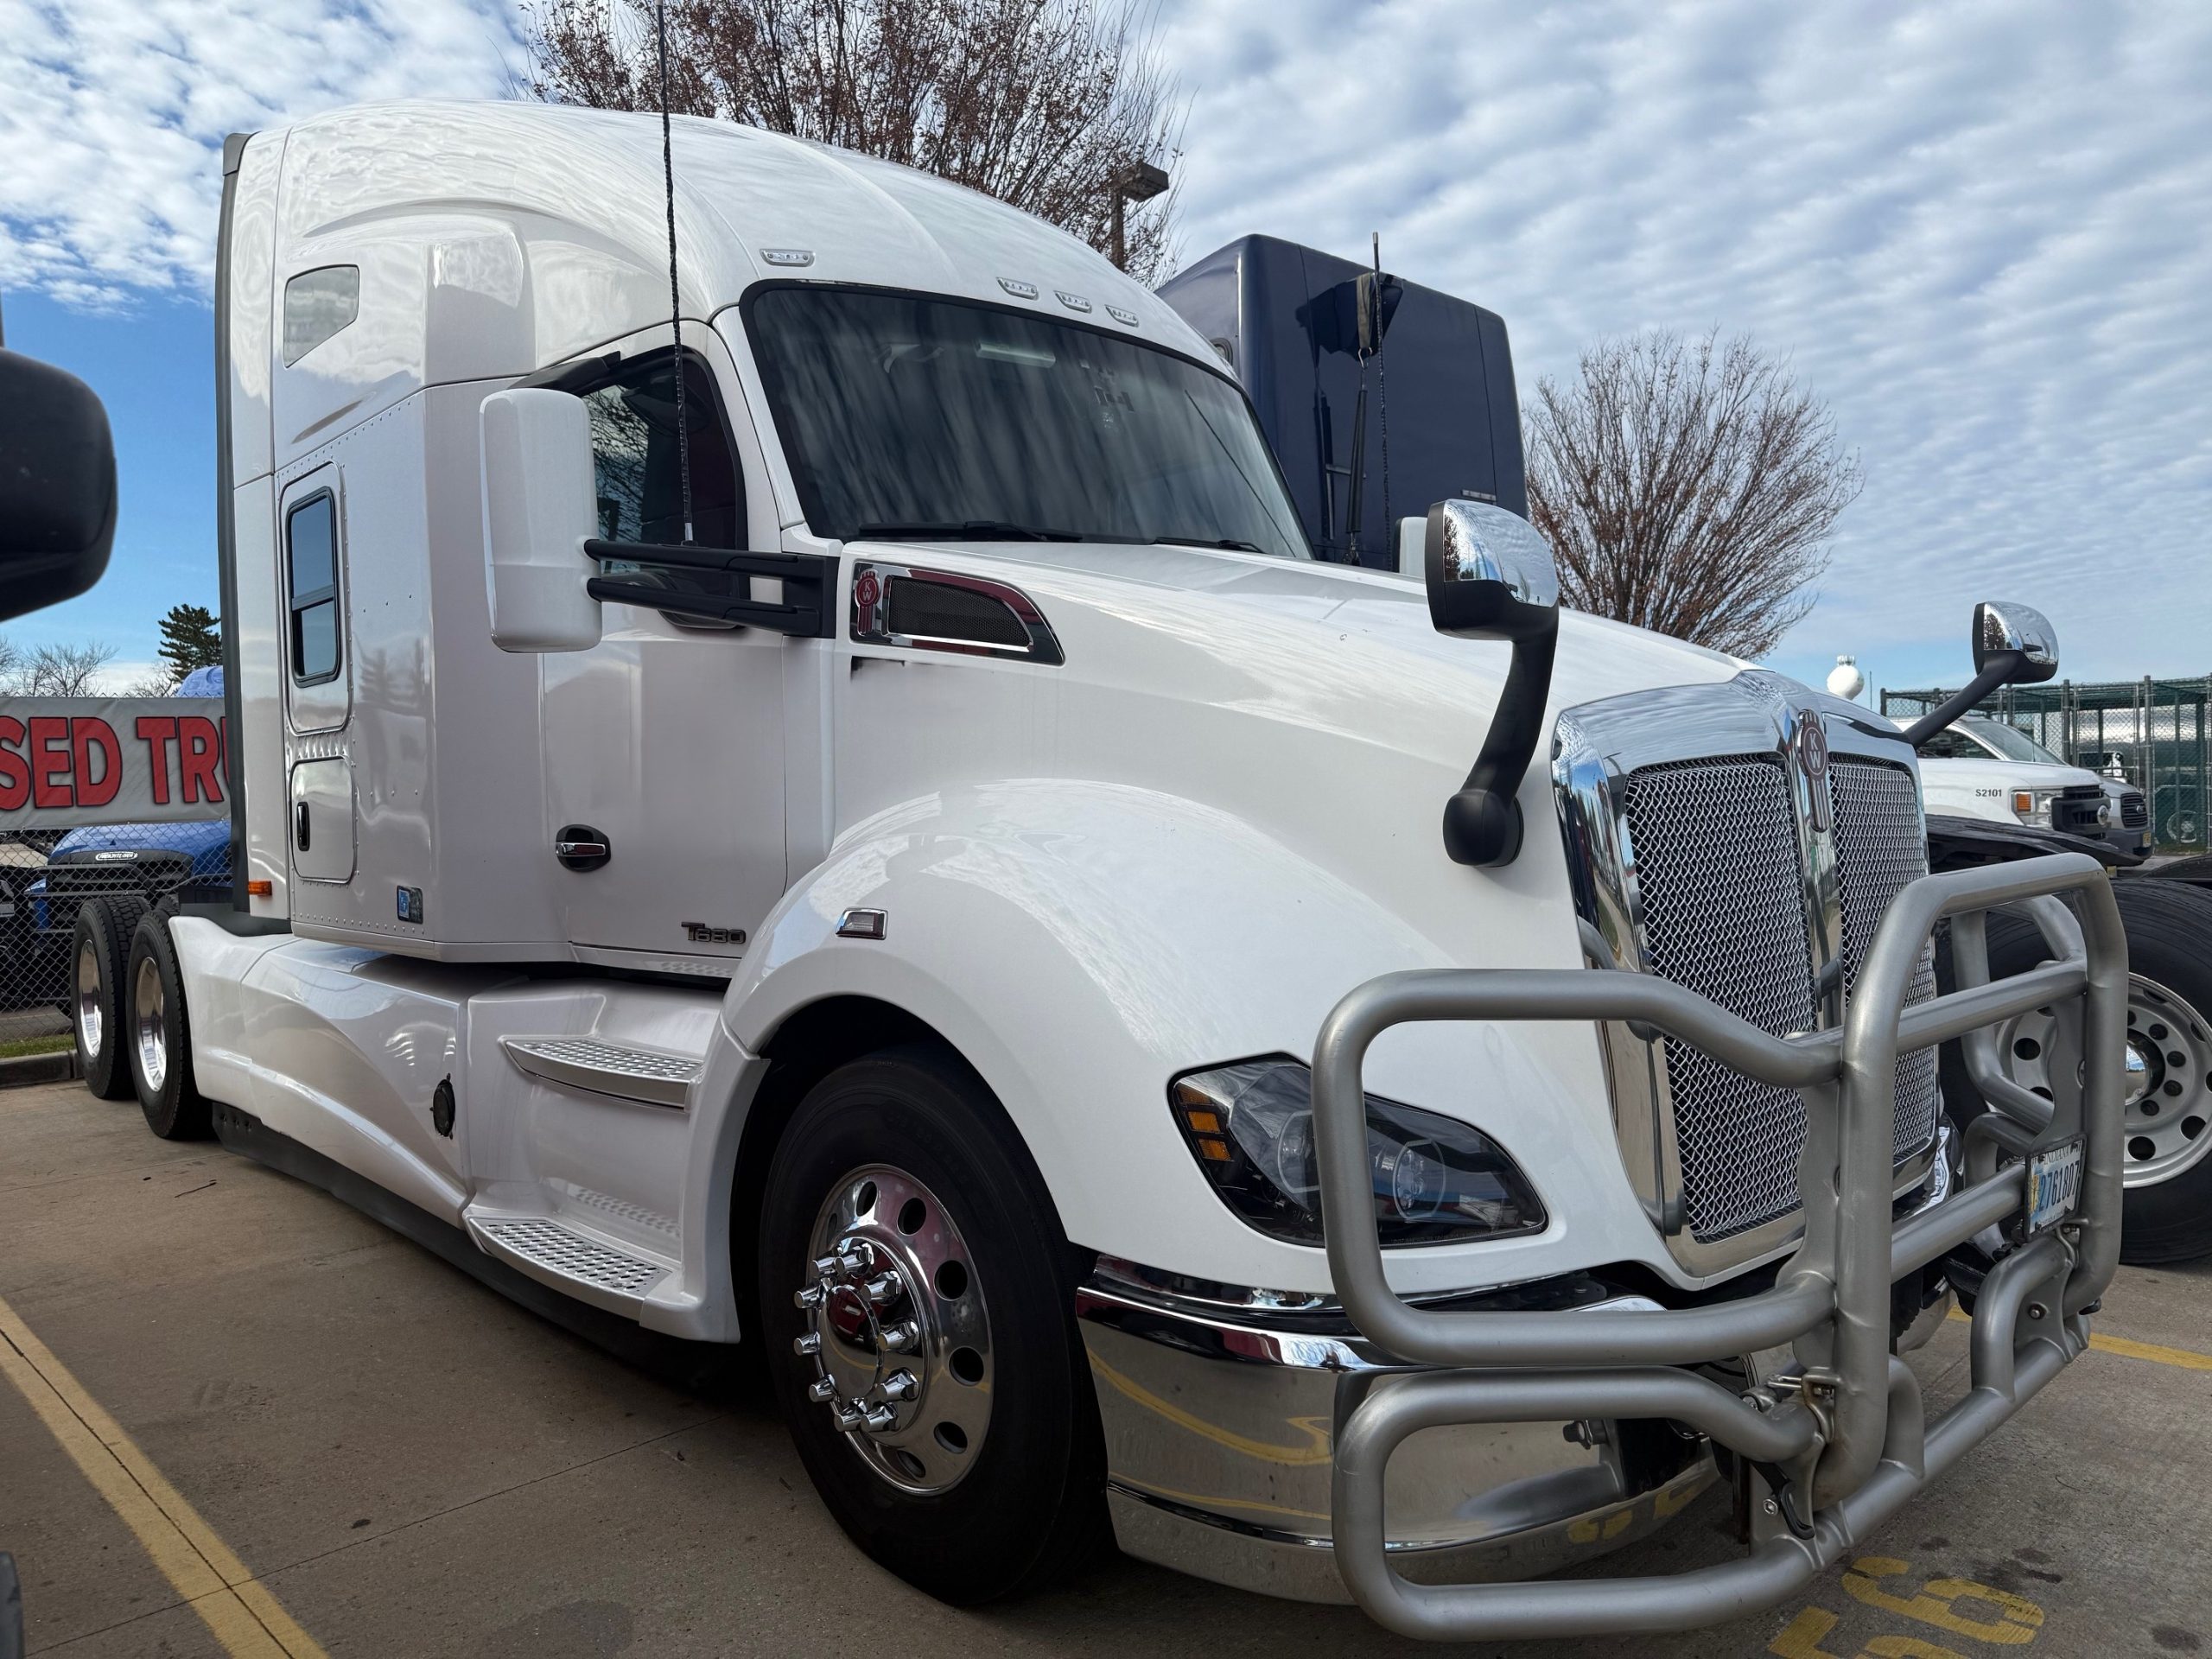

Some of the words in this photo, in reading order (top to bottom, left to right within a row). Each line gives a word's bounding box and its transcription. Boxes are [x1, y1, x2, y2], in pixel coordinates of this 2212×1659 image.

[136, 716, 231, 804] TR
[1974, 788, 2002, 798] S2101
[681, 921, 746, 944] T680
[2038, 1160, 2080, 1211] 2761807
